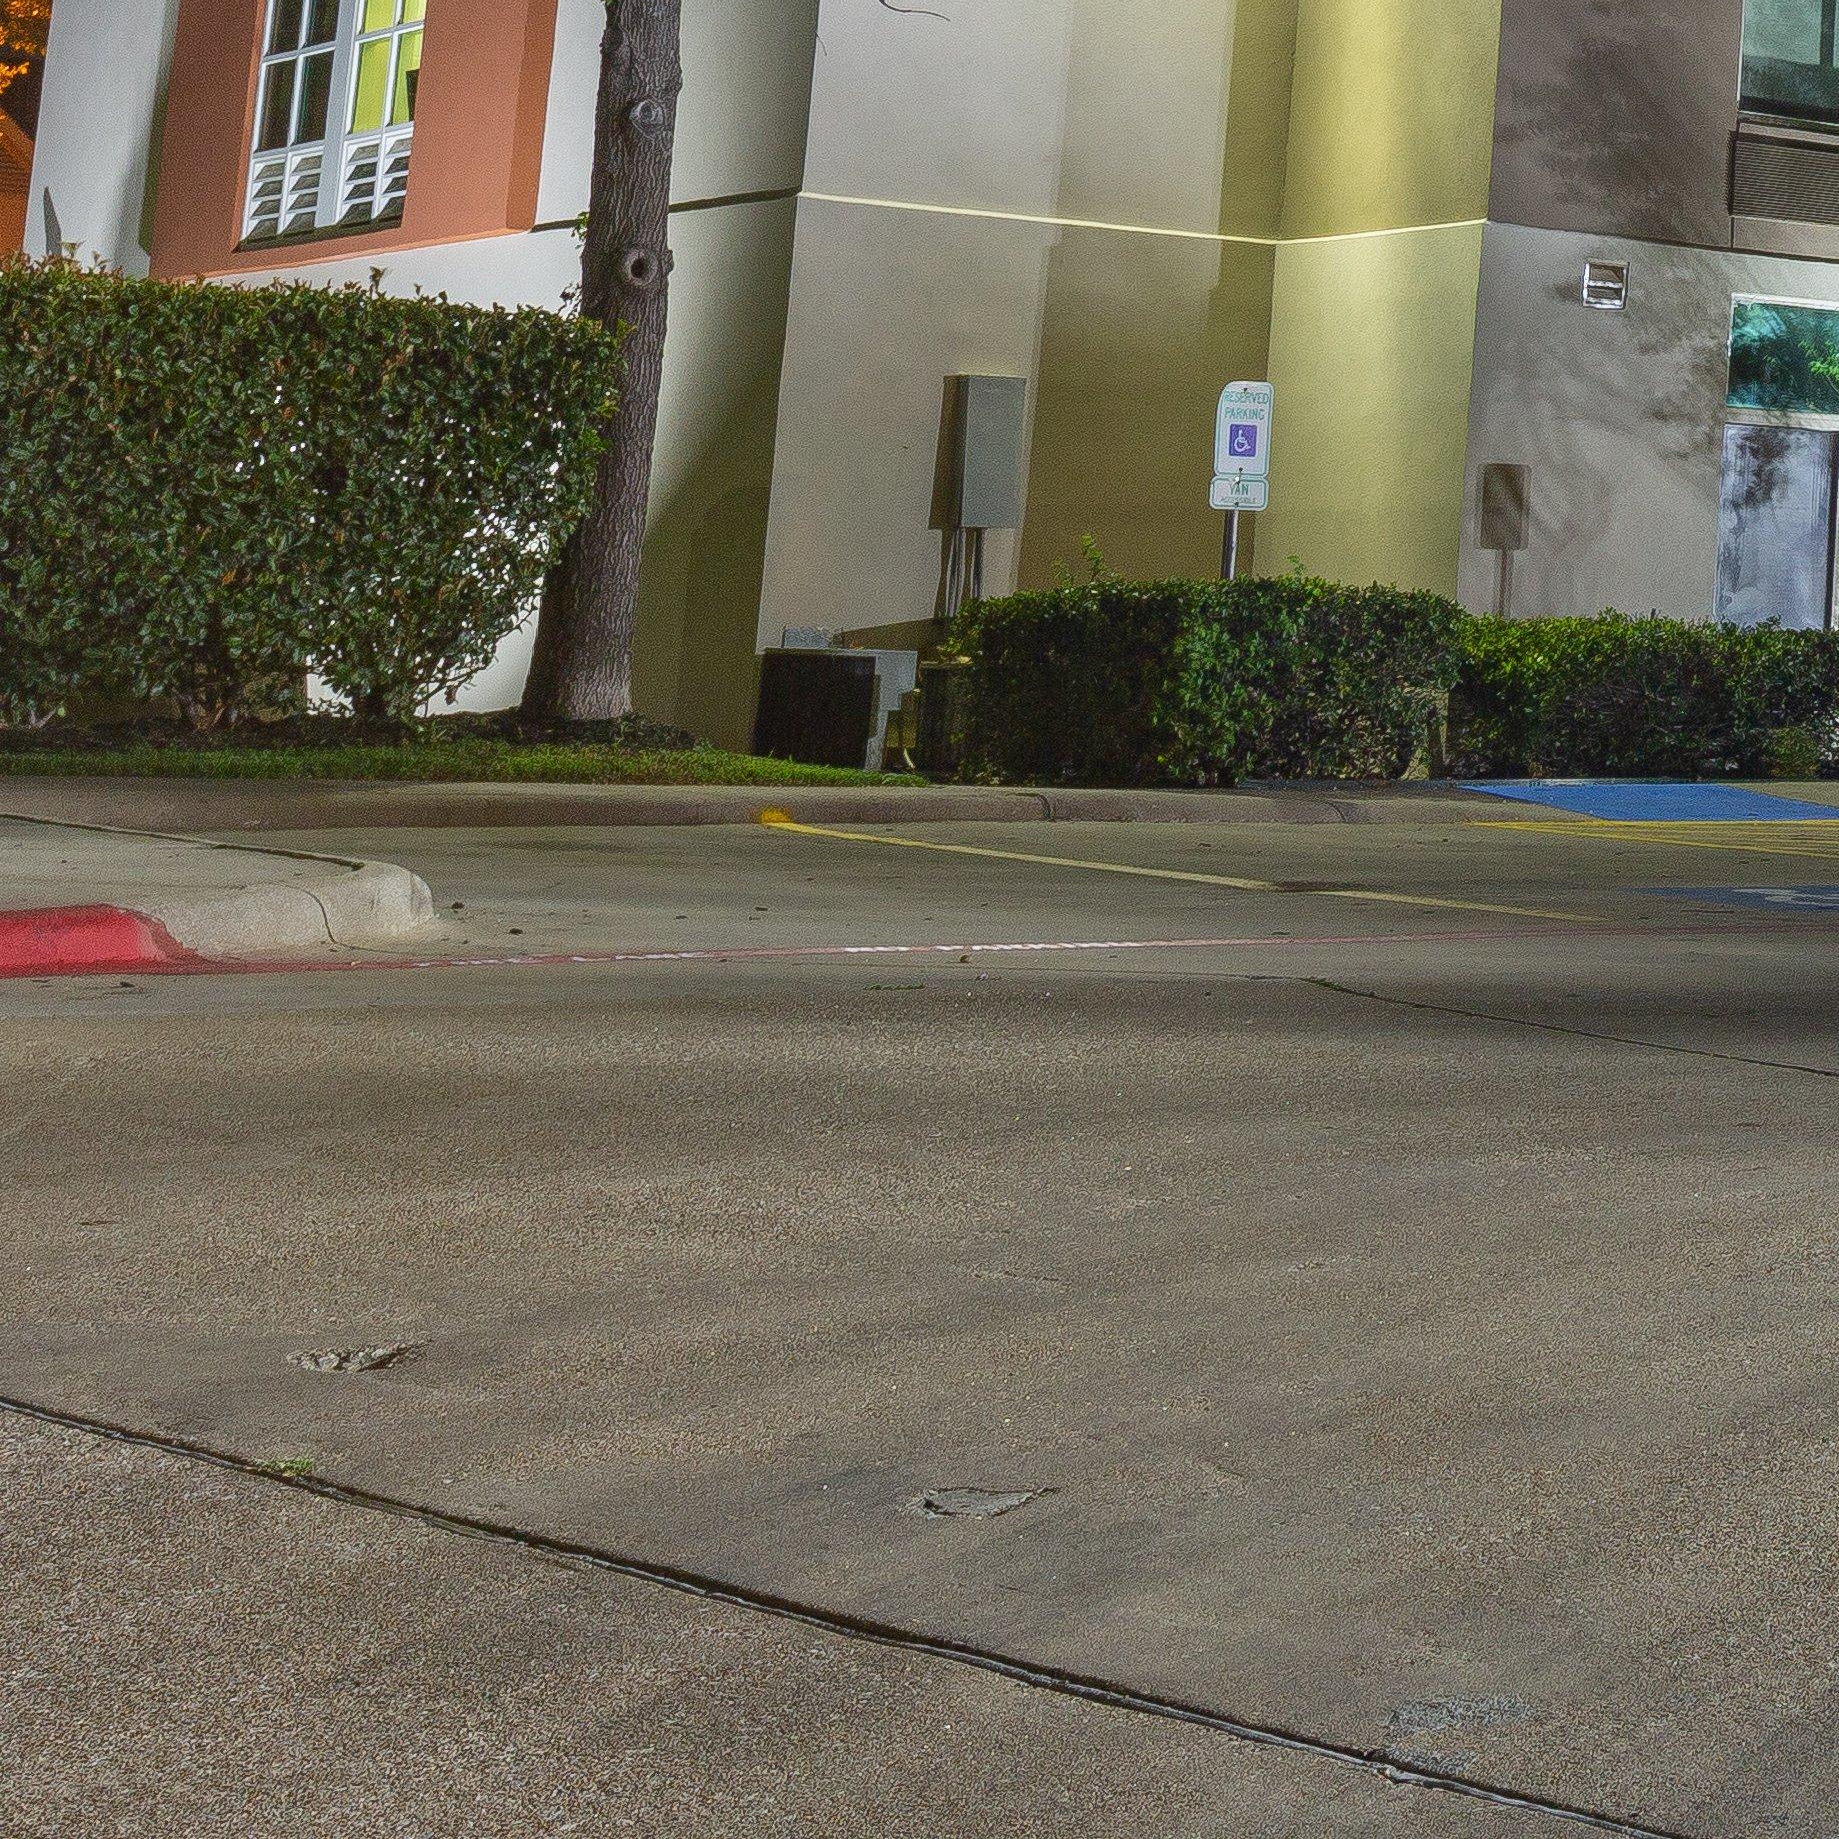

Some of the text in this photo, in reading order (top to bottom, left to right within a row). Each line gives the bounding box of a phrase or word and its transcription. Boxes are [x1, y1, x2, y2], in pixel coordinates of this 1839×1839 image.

[1223, 391, 1269, 404] RESERVED
[1224, 407, 1265, 420] PARKING
[1230, 483, 1249, 495] VAN
